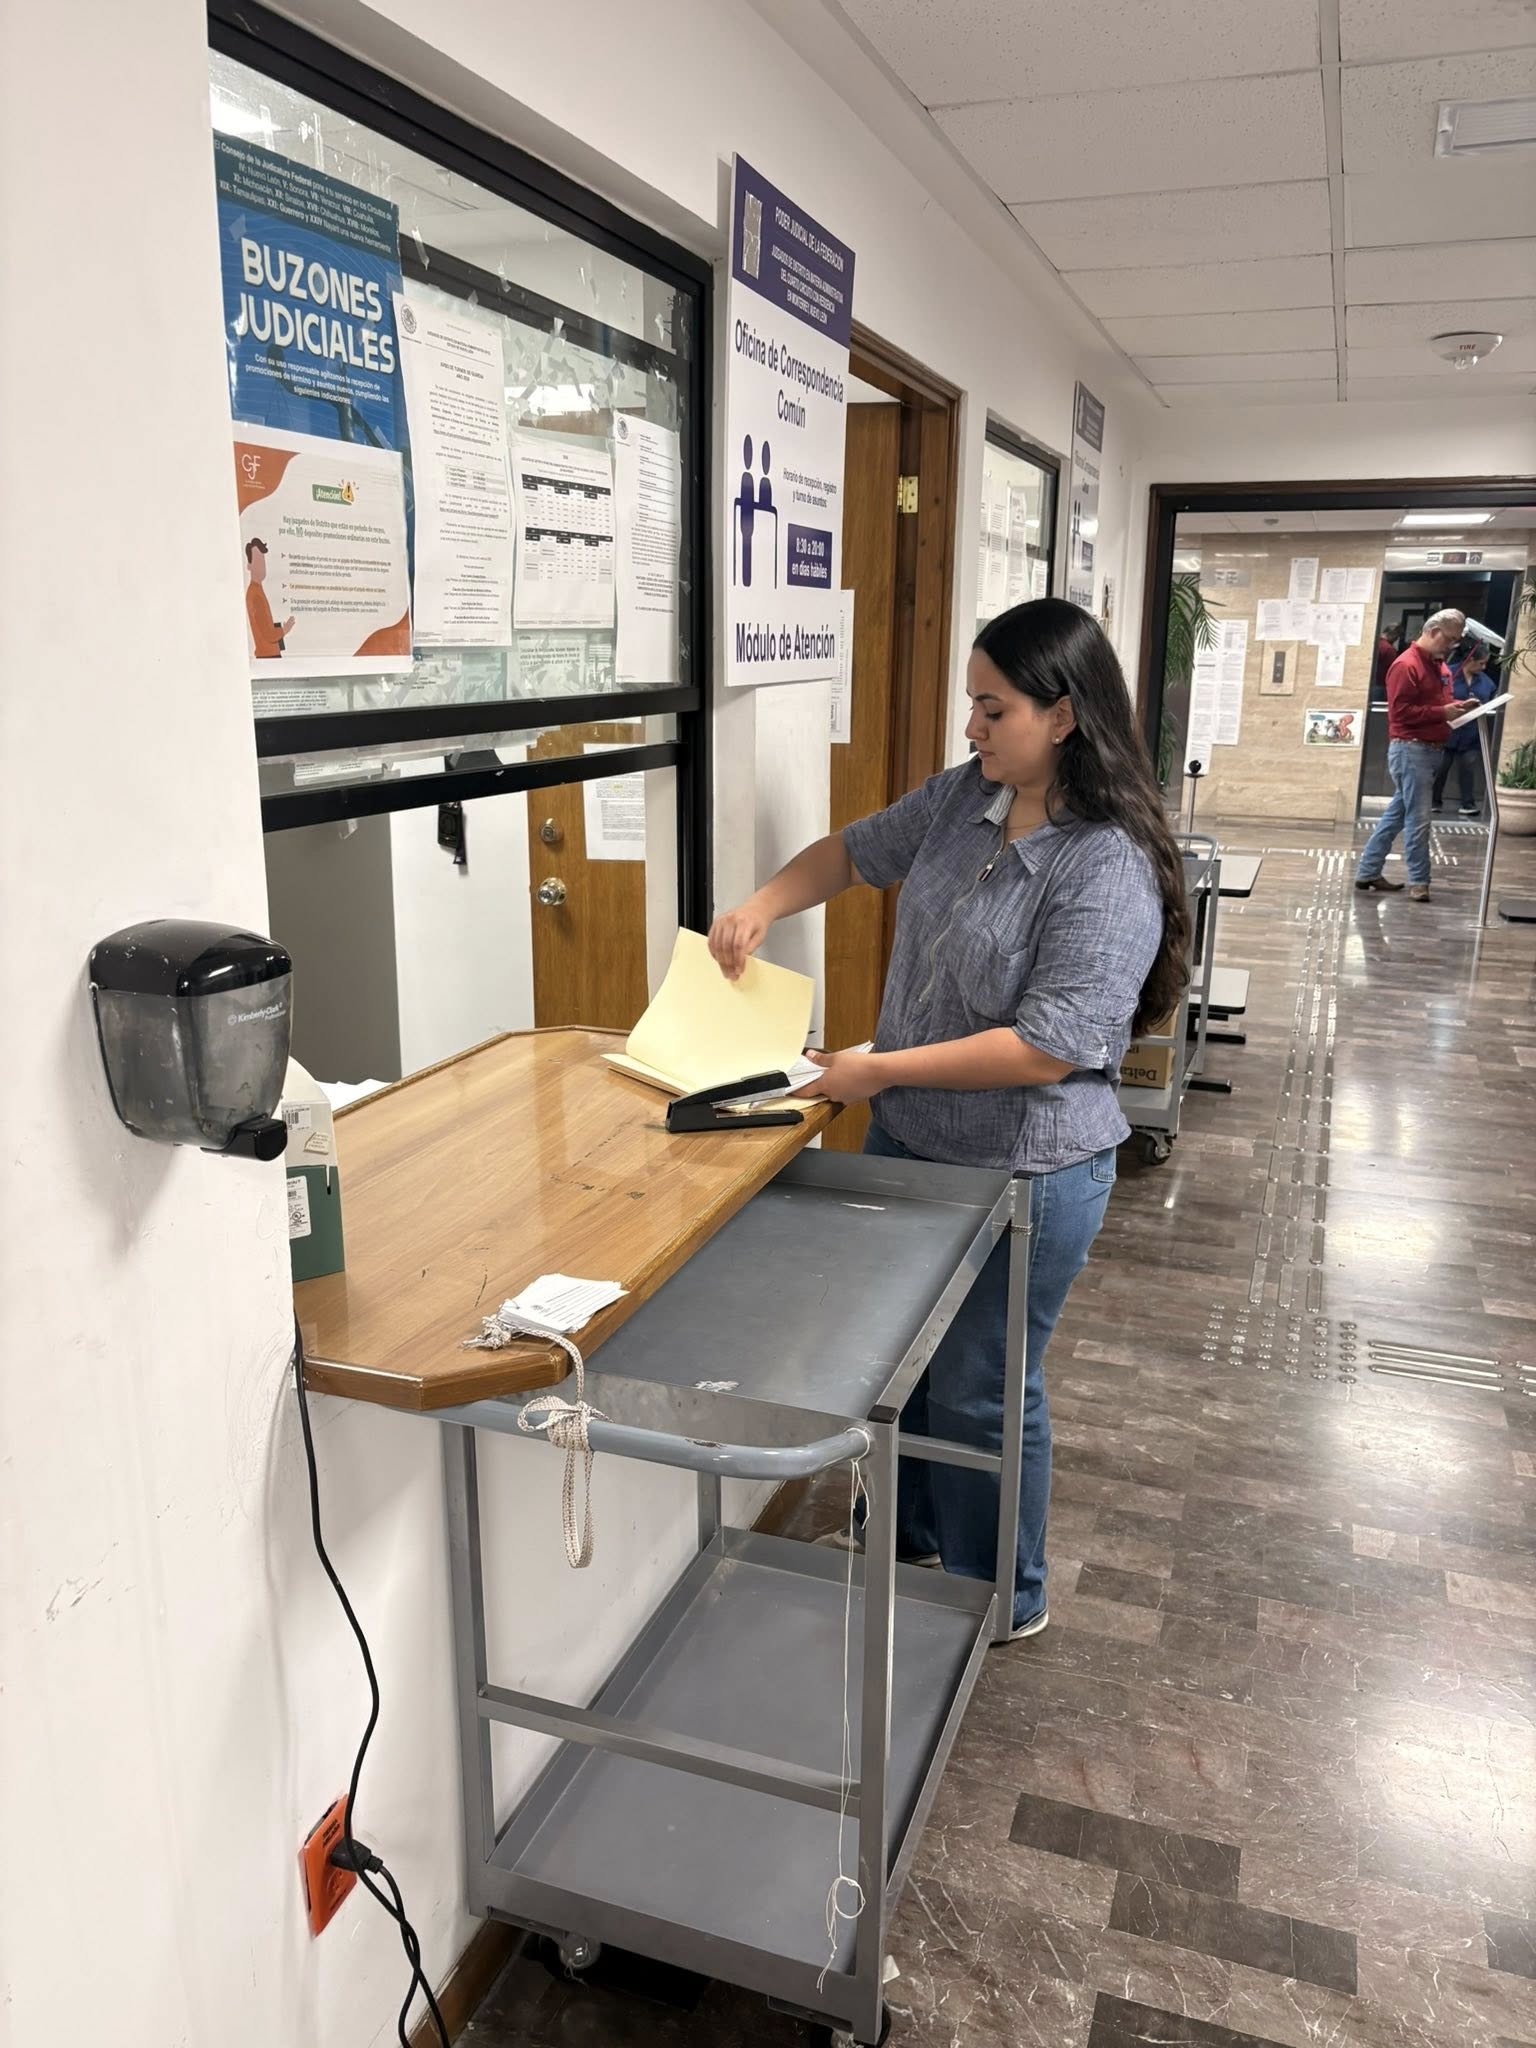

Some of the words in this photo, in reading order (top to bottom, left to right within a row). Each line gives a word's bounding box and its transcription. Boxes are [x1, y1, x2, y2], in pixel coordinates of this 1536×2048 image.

[291, 173, 312, 187] Federal
[775, 206, 791, 233] PODER
[790, 218, 808, 246] JUDICIAL
[808, 233, 814, 251] DE
[814, 238, 820, 256] LA
[820, 241, 844, 274] FEDERACIÓN
[241, 237, 383, 323] BUZONES
[234, 292, 396, 374] JUDICIALES
[246, 365, 282, 378] promociones
[255, 354, 267, 363] Con
[736, 318, 766, 365] Oficina
[769, 339, 778, 371] de
[781, 344, 844, 404] Correspondencia
[778, 390, 806, 428] Común
[783, 468, 797, 482] Horario
[799, 473, 803, 484] de
[823, 482, 837, 496] registro
[793, 491, 795, 502] y
[795, 490, 806, 502] turno
[807, 493, 812, 504] de
[796, 536, 807, 554] 8:30
[807, 542, 811, 555] a
[811, 539, 824, 557] 20:00
[792, 562, 798, 575] en
[800, 560, 810, 577] días
[810, 562, 828, 580] hábiles
[735, 621, 776, 663] Módulo
[779, 623, 792, 661] de
[793, 622, 836, 660] Atención
